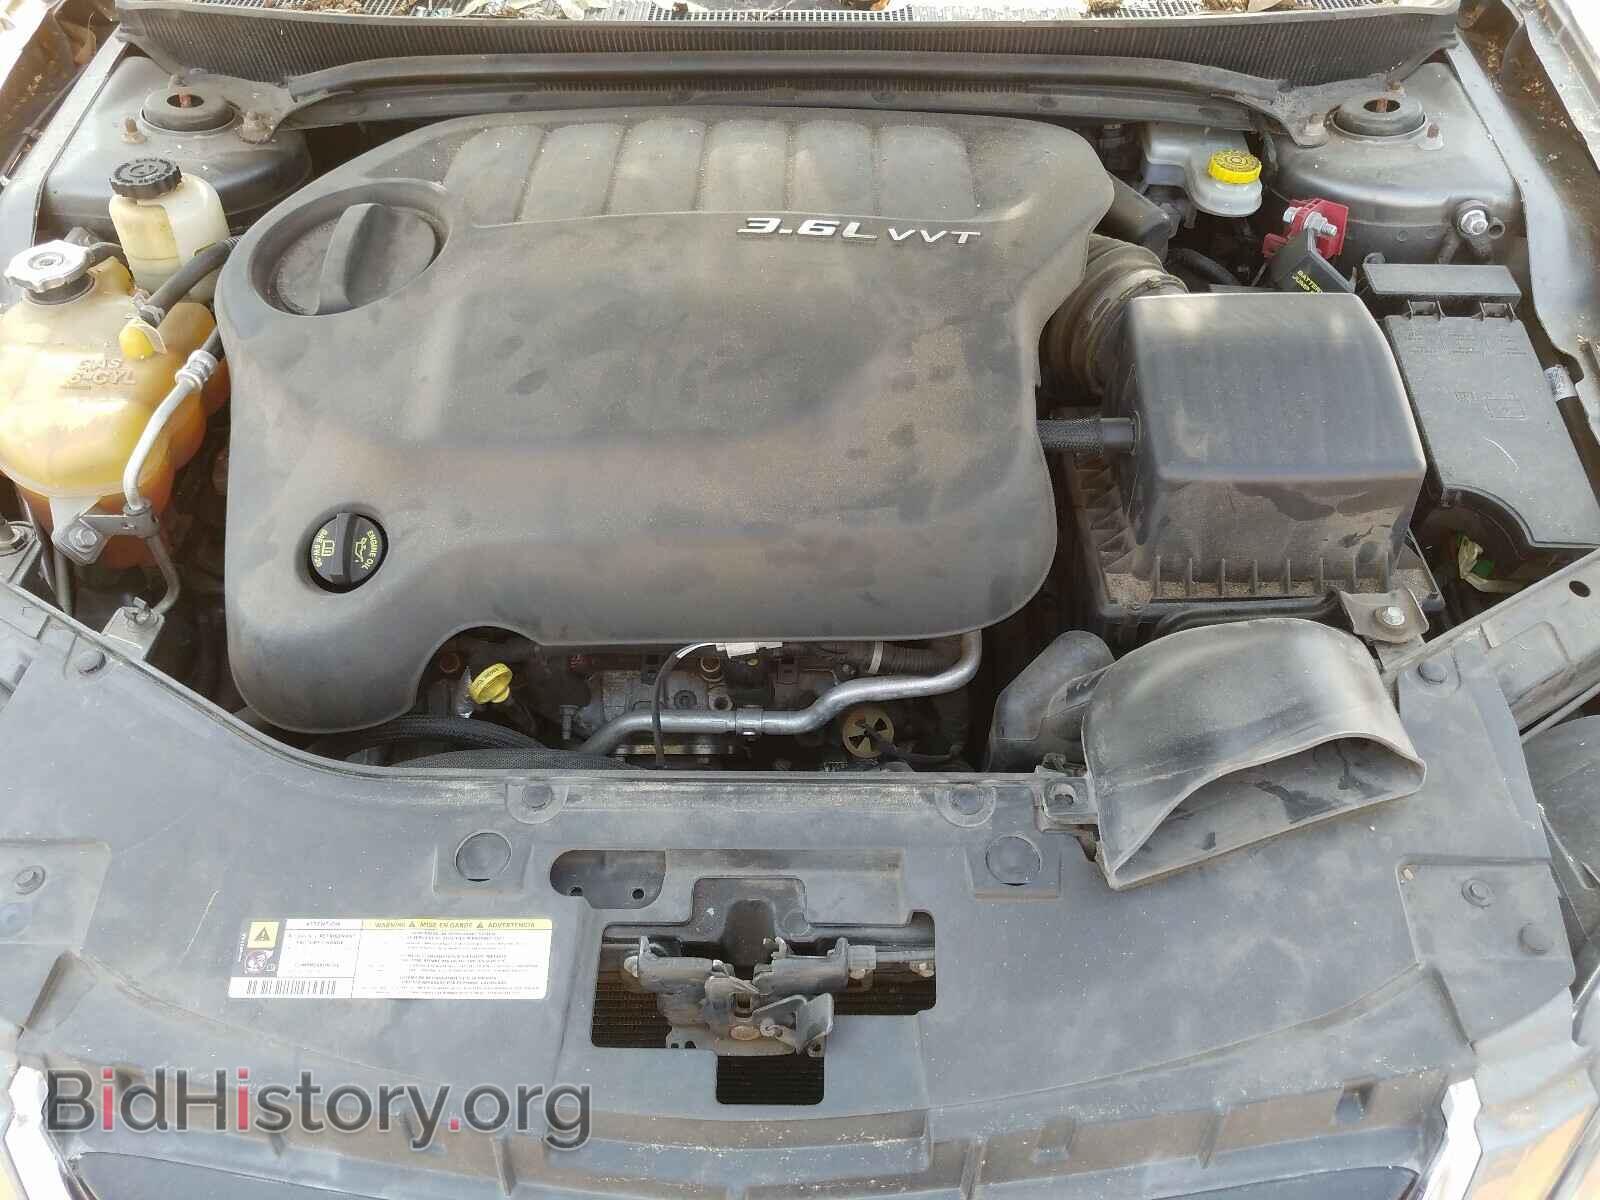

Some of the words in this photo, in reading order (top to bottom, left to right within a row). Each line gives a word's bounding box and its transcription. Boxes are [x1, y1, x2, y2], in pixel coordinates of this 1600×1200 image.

[736, 217, 878, 239] 3.6L
[888, 227, 981, 244] VVT
[1297, 270, 1323, 293] BATTER
[366, 529, 378, 557] ENGINE
[361, 558, 374, 570] OIL
